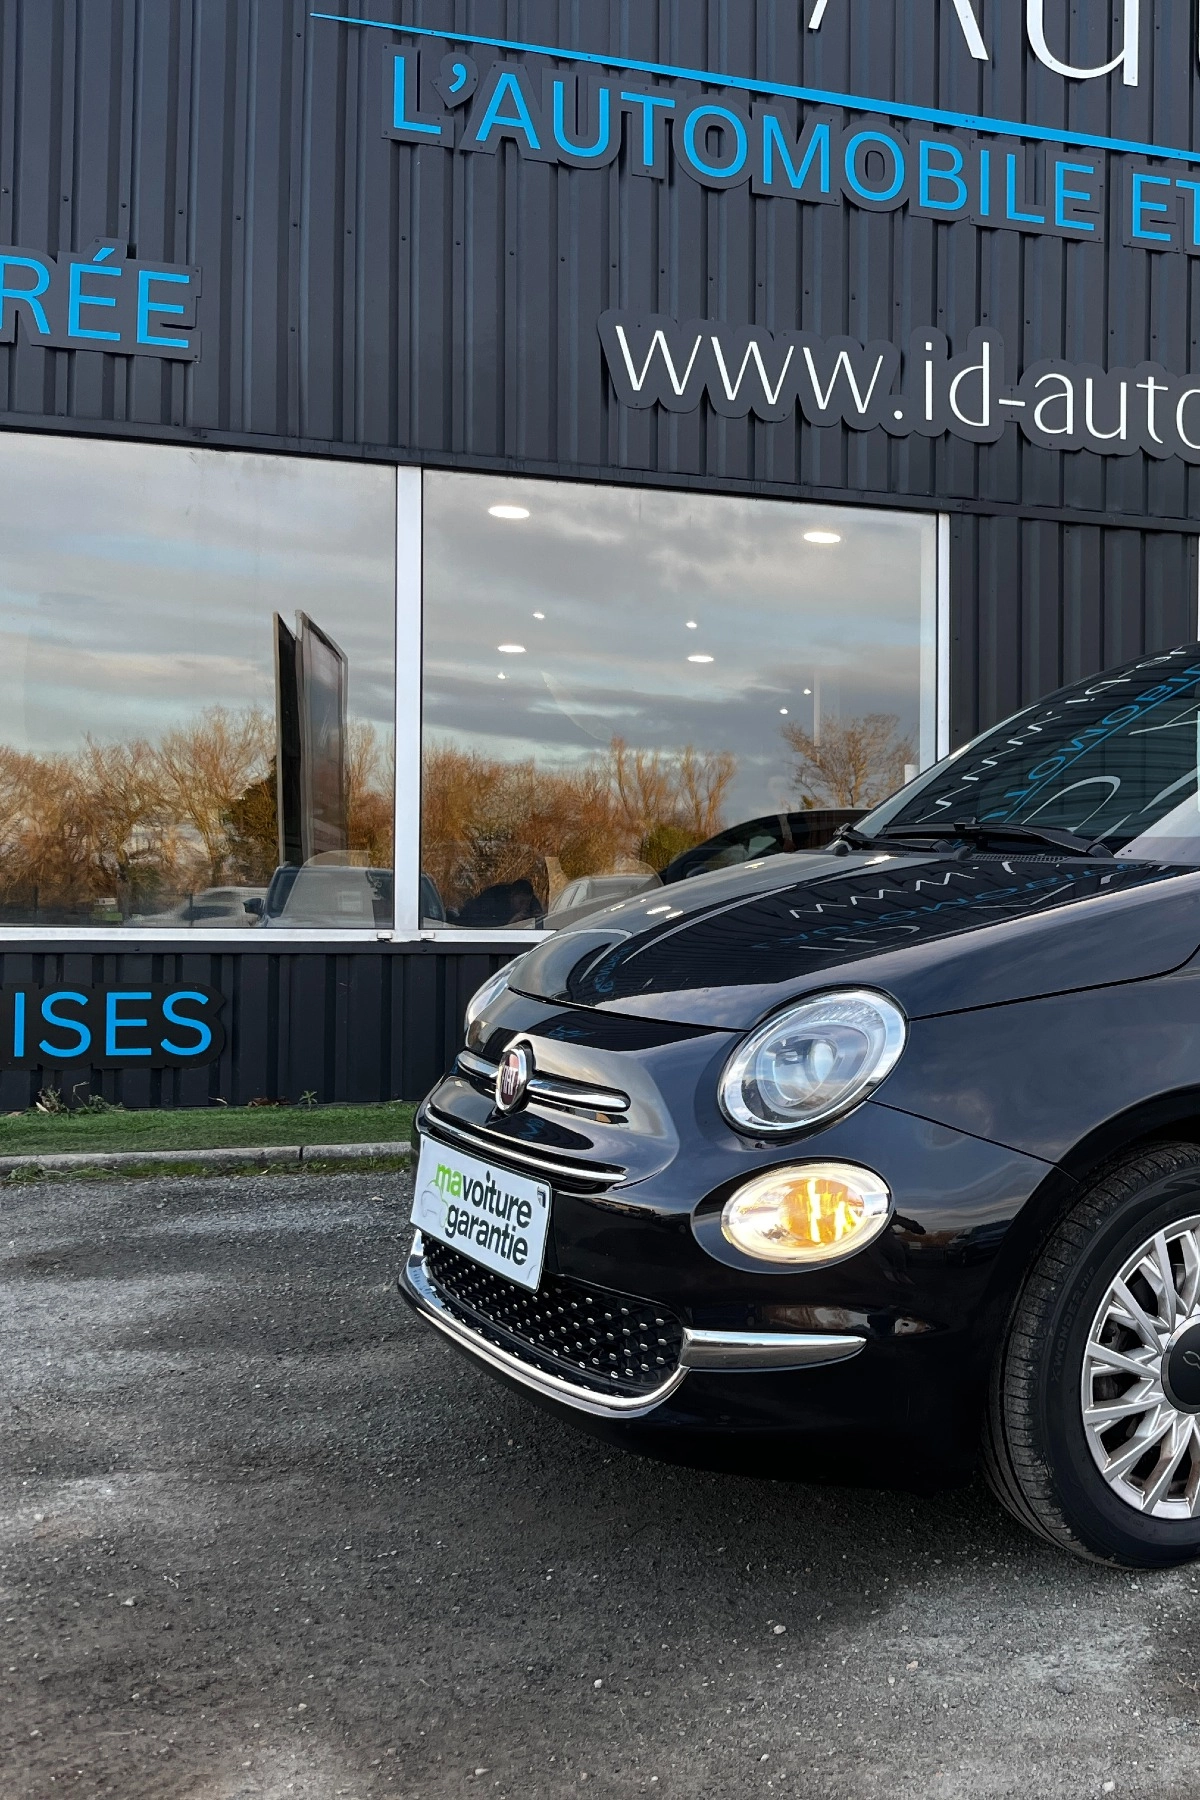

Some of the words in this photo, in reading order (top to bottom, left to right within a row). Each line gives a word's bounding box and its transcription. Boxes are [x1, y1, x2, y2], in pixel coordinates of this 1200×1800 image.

[0, 247, 190, 349] RÉE
[14, 991, 212, 1057] ISES
[435, 1163, 532, 1229] mavoiture
[444, 1204, 529, 1266] garantie
